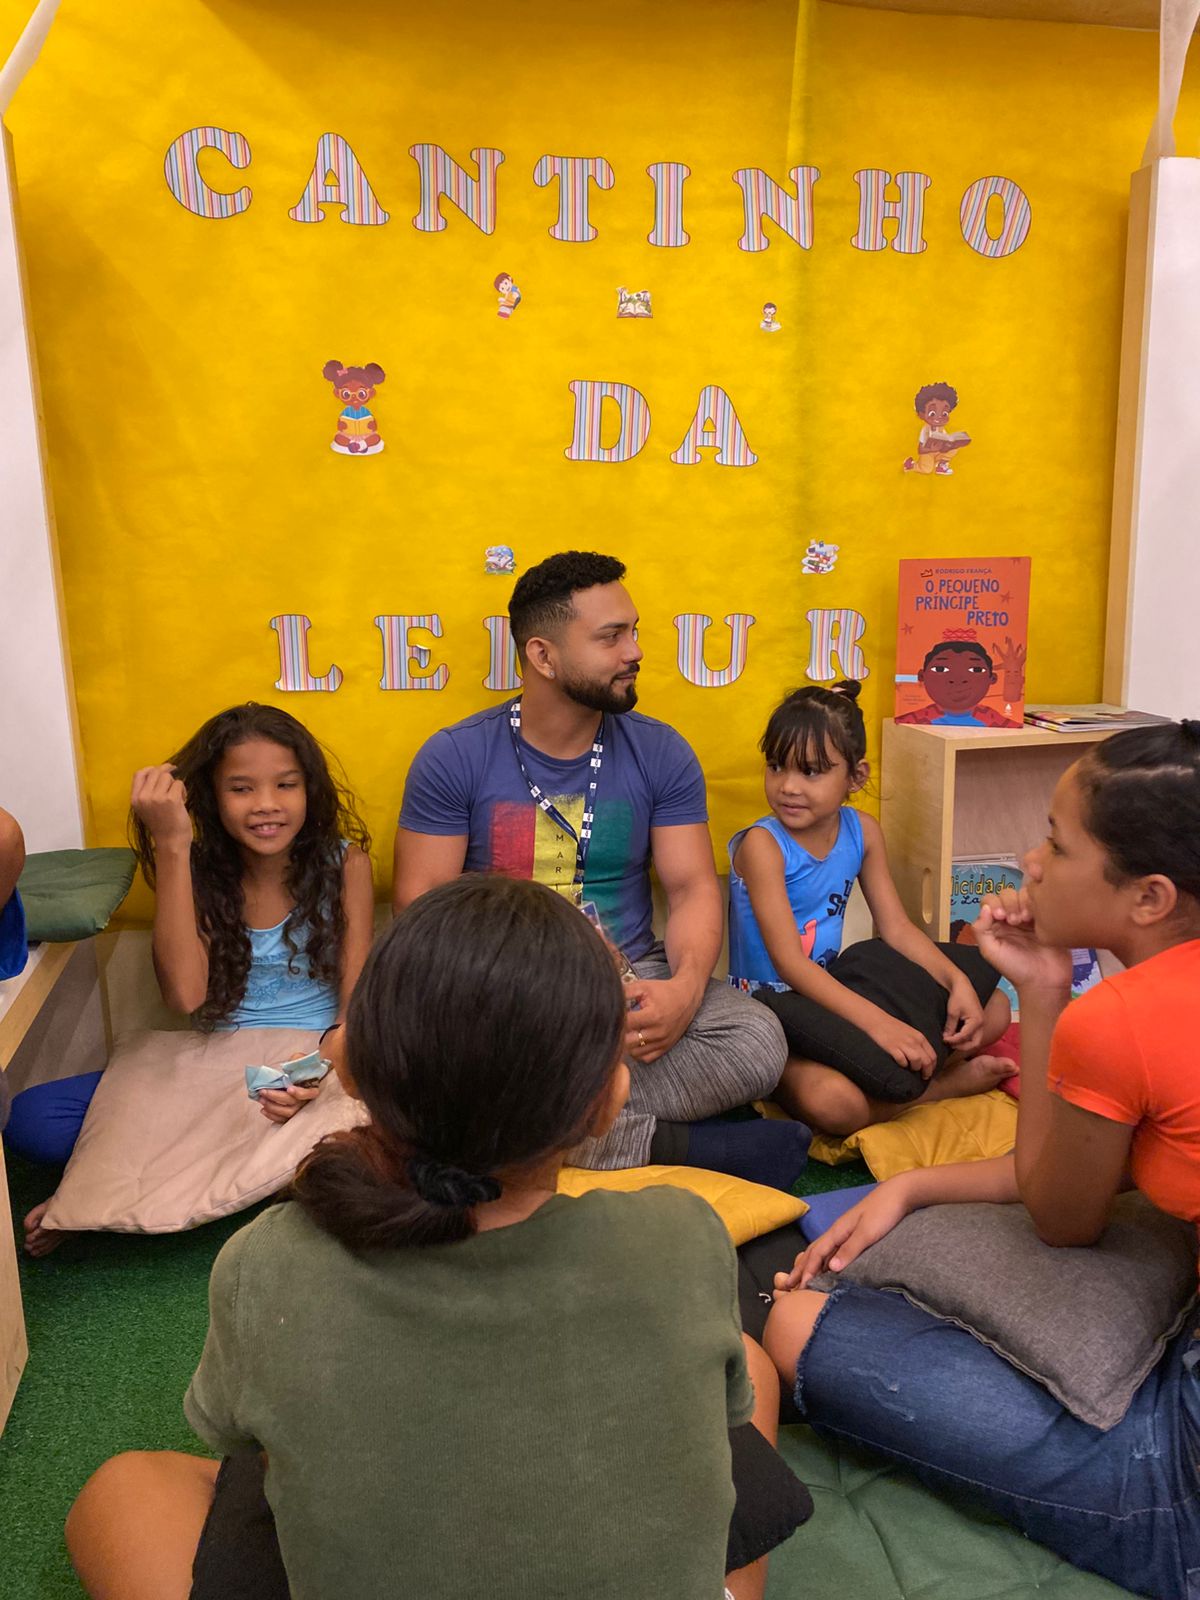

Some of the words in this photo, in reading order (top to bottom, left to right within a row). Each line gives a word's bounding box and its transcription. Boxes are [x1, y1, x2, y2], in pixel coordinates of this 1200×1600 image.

[164, 126, 1032, 258] CANTINHO
[563, 379, 758, 467] DA
[915, 592, 980, 611] PRÍNCIPE
[925, 580, 934, 593] O
[939, 579, 1000, 594] PEQUENO
[967, 611, 1009, 627] PRETO
[270, 608, 870, 692] LEIUR
